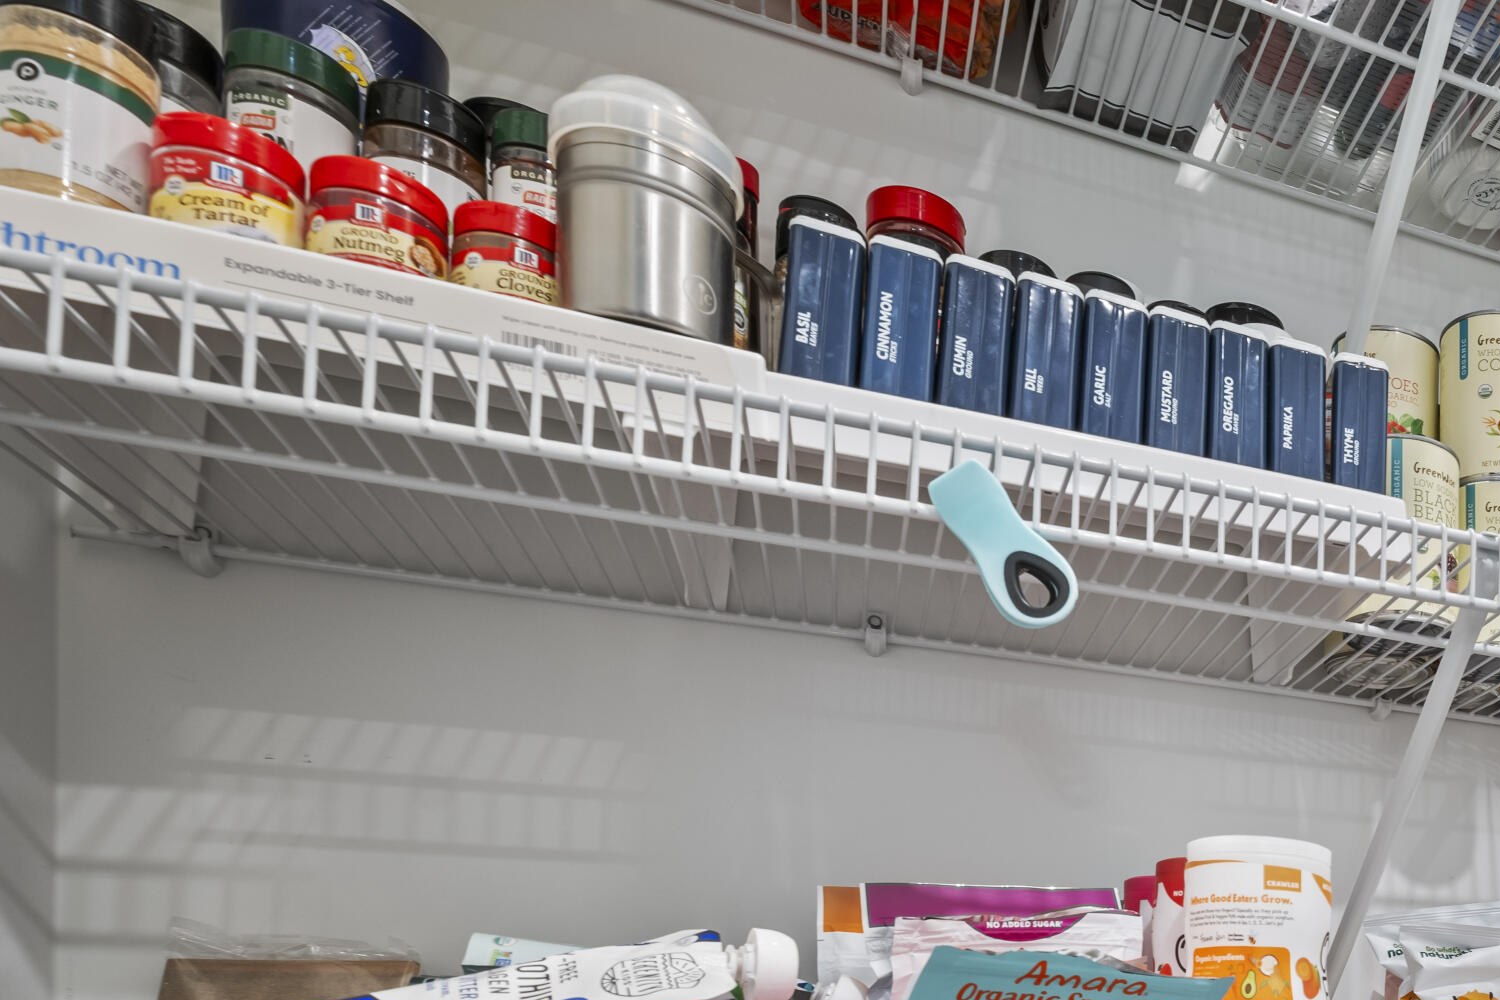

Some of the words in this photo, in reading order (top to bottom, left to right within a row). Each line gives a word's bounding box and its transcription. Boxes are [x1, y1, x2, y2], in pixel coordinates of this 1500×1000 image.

[232, 92, 285, 106] ORGANIC
[179, 193, 247, 213] Cream
[250, 200, 271, 217] of
[193, 207, 259, 228] Tartar
[340, 227, 398, 244] GROUND
[334, 237, 405, 264] Nutmeg
[225, 258, 322, 288] Expandable
[326, 279, 372, 299] 3-Tier
[375, 289, 414, 306] Shelf
[497, 278, 553, 303] Cloves
[499, 268, 551, 290] GROUND
[795, 311, 811, 344] BASIL
[810, 321, 818, 347] LEAVES
[876, 291, 893, 360] CINNAMON
[889, 341, 898, 363] STICKS
[952, 335, 967, 376] CUMIN
[965, 350, 973, 379] GROUND
[1024, 368, 1037, 392] DILL
[1035, 375, 1044, 394] WEED
[1093, 365, 1107, 405] GARLIC
[1160, 370, 1173, 423] MUSTARD
[1223, 376, 1234, 432] OREGANO
[1232, 413, 1240, 435] LEAVES
[1283, 406, 1293, 449] PAPRIKA
[1344, 428, 1355, 464] THYME
[1413, 461, 1456, 488] GreenWise
[1413, 478, 1433, 489] LOW
[1414, 488, 1456, 514] BLACK
[1211, 894, 1232, 903] Good
[1233, 893, 1259, 904] Eaters
[1261, 894, 1294, 905] Grow.
[986, 920, 1000, 929] NO
[1001, 919, 1031, 929] ADDED
[632, 954, 662, 994] SERENITY
[1015, 960, 1148, 996] Amara
